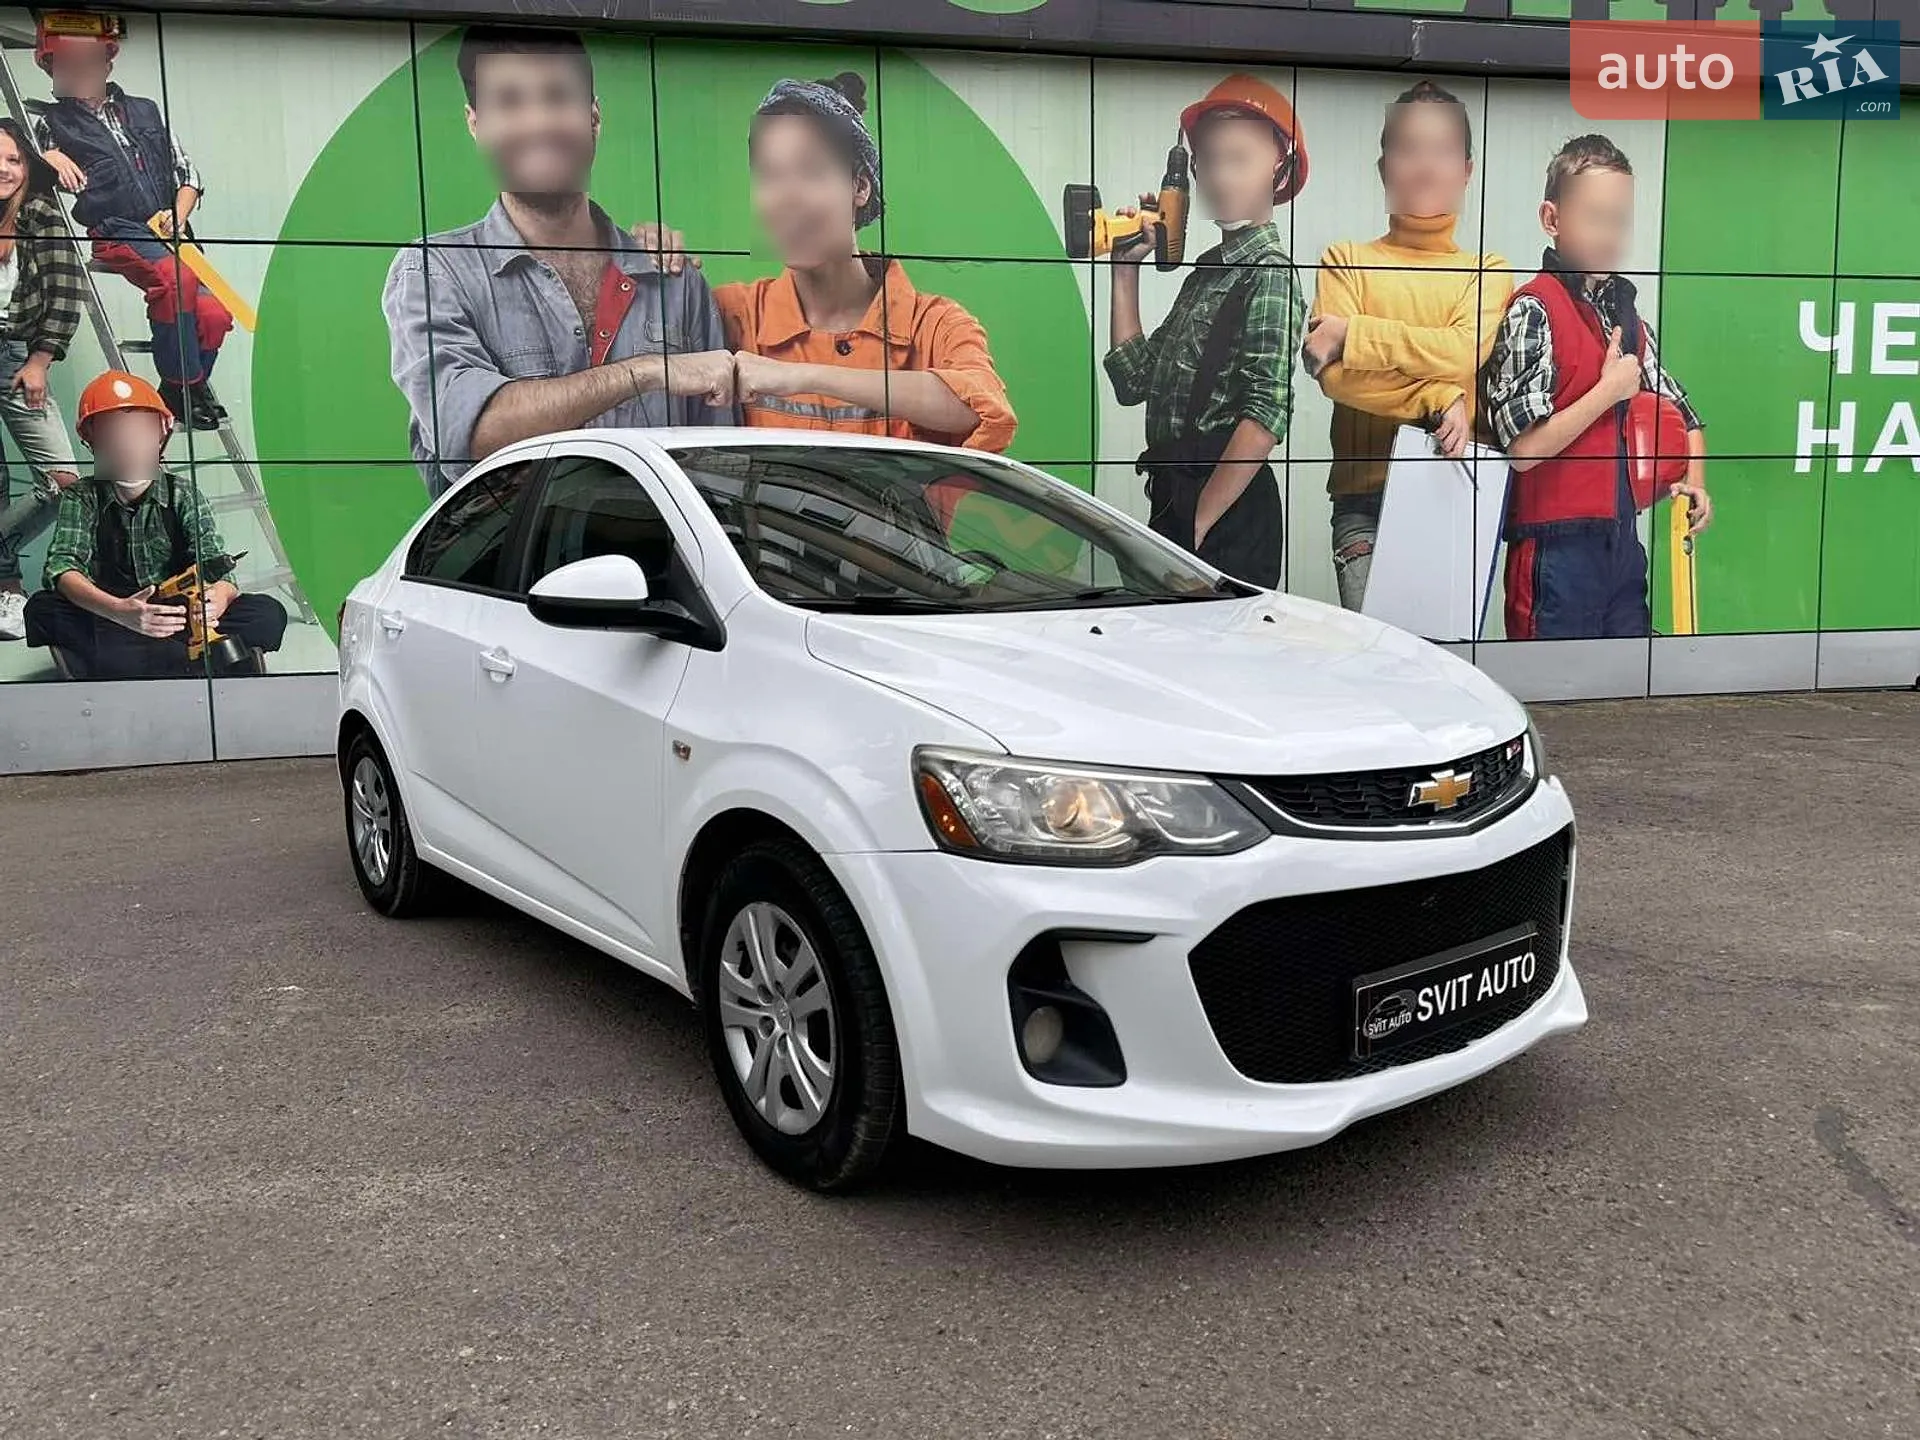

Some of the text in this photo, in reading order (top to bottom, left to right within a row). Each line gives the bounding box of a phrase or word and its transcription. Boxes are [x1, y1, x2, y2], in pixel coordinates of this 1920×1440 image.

[1799, 301, 1920, 375] ЧЕ
[1416, 952, 1536, 1022] SVIT AUTO
[1368, 1011, 1412, 1036] SVIT AUTO
